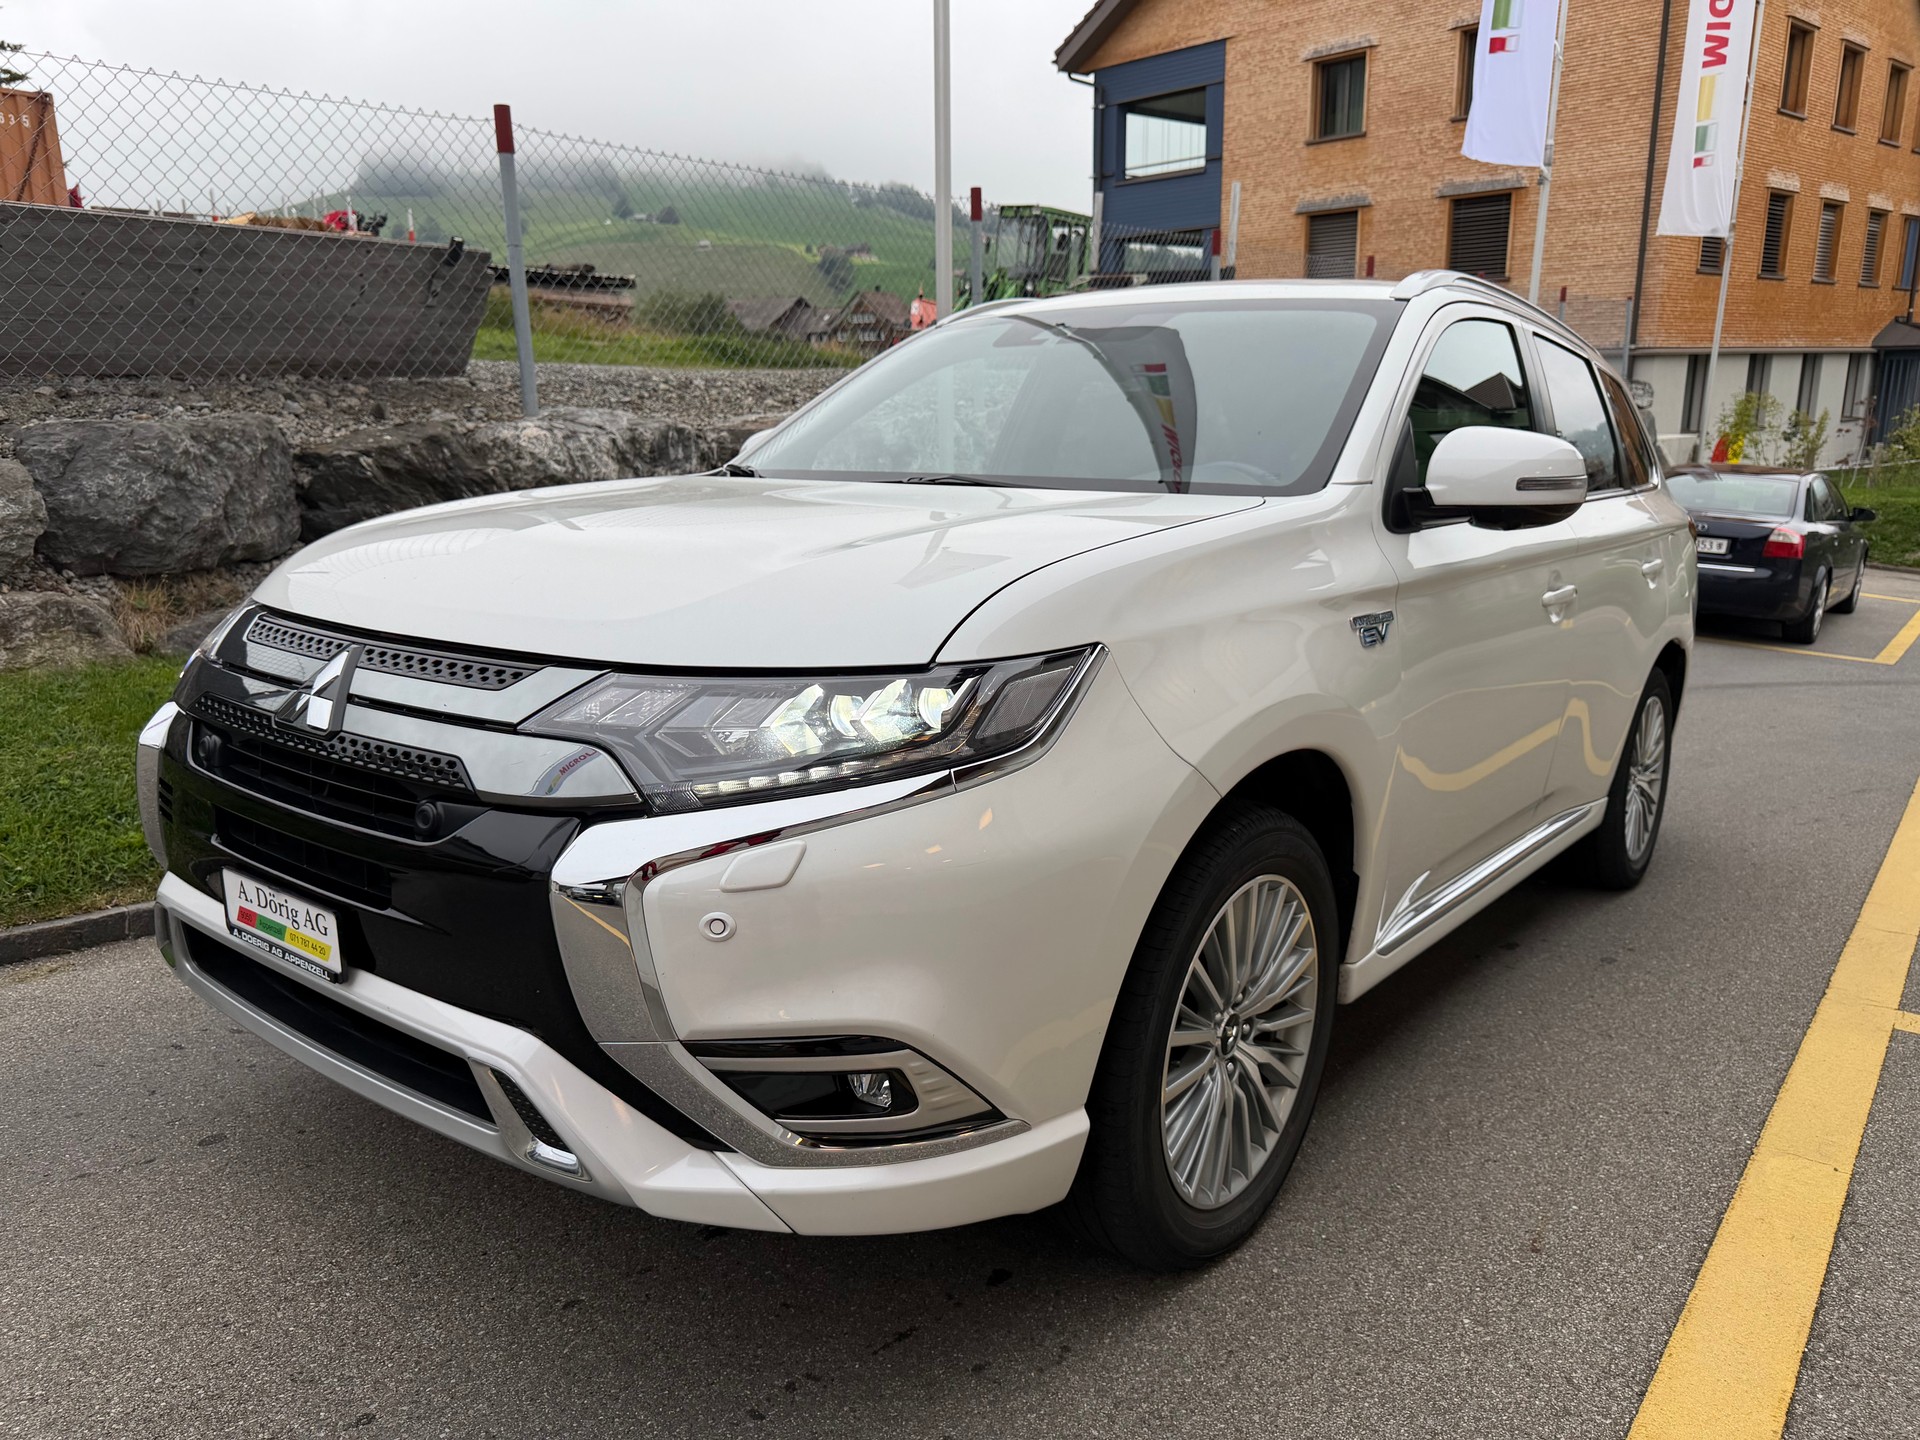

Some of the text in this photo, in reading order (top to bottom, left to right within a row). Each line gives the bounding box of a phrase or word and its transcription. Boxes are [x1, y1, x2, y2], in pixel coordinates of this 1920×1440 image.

[1359, 622, 1391, 647] EV
[238, 880, 328, 936] A. Dörig AG
[233, 928, 331, 981] A. DOERIG AG APPENZELL
